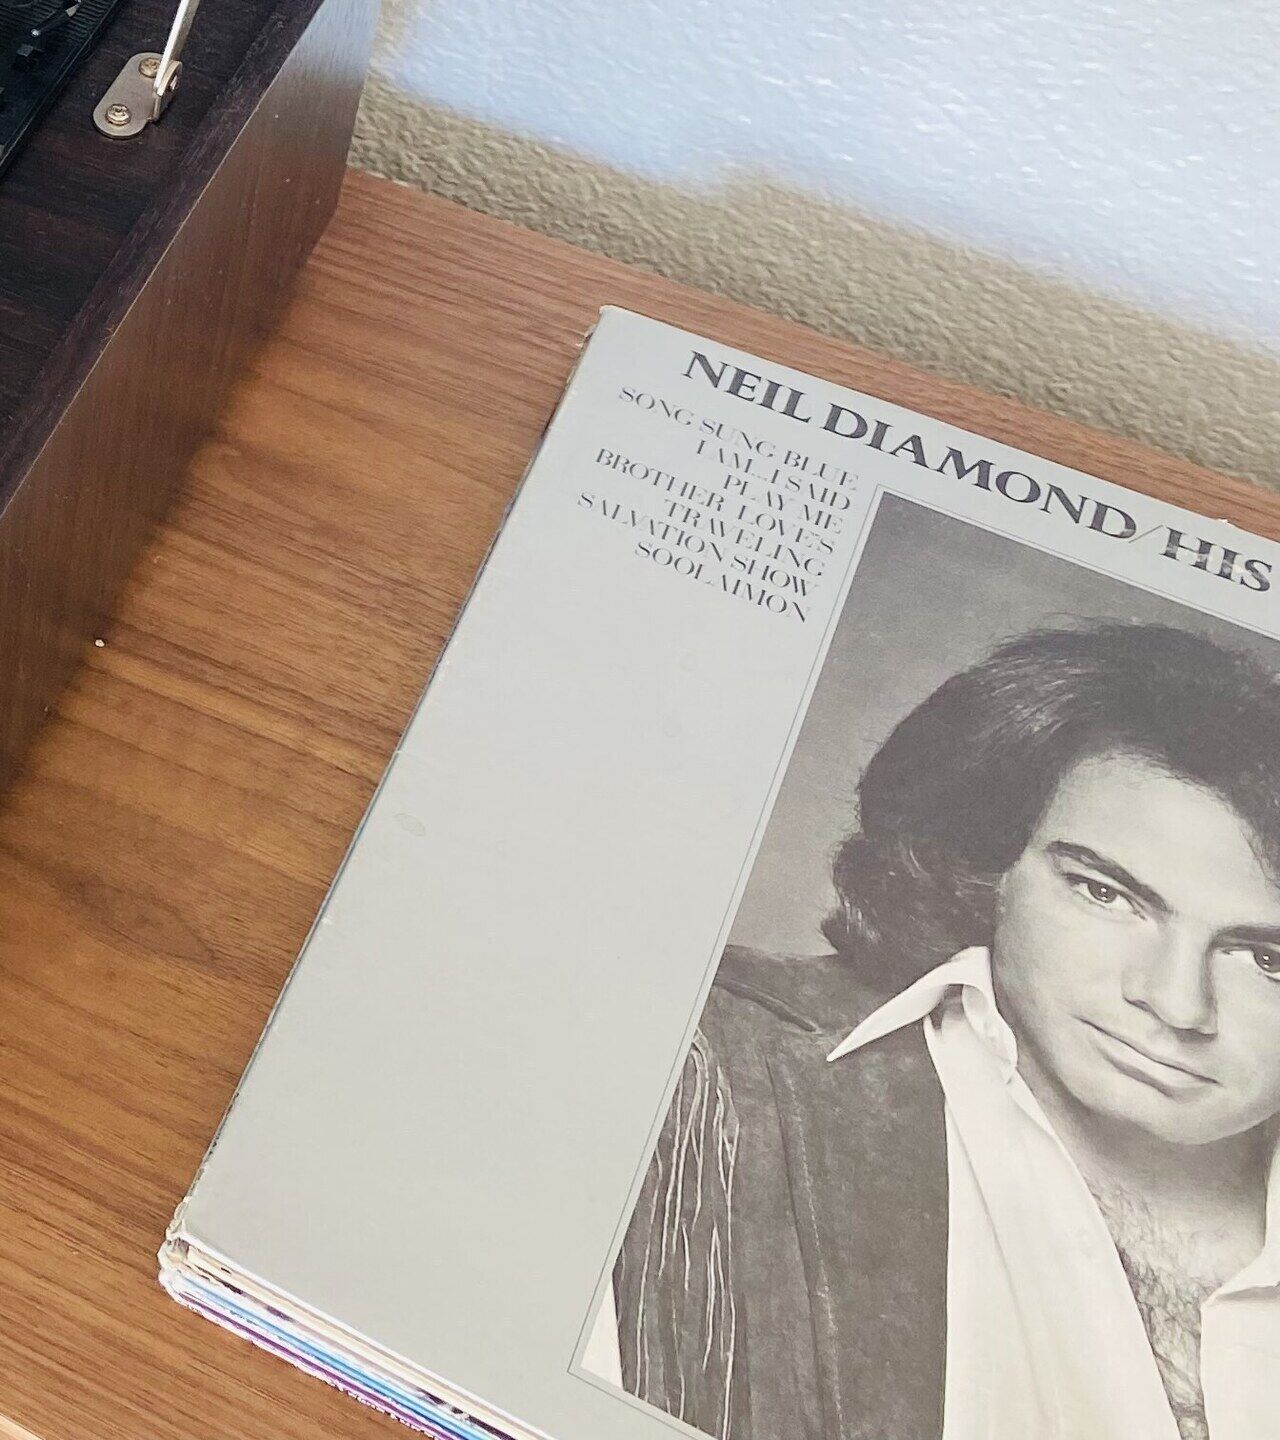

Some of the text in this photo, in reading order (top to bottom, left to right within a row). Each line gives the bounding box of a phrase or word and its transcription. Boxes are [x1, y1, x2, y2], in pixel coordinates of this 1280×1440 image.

[681, 350, 812, 424] NEIL
[618, 385, 859, 492] SONG SUNG BLUE
[595, 448, 726, 513] BROTHER
[723, 474, 845, 536] PLAY ME
[785, 475, 852, 511] SAID
[576, 492, 820, 598] SALVATION SHOW
[663, 498, 826, 578] TRAVELING
[634, 541, 812, 624] SOOLAIMON
